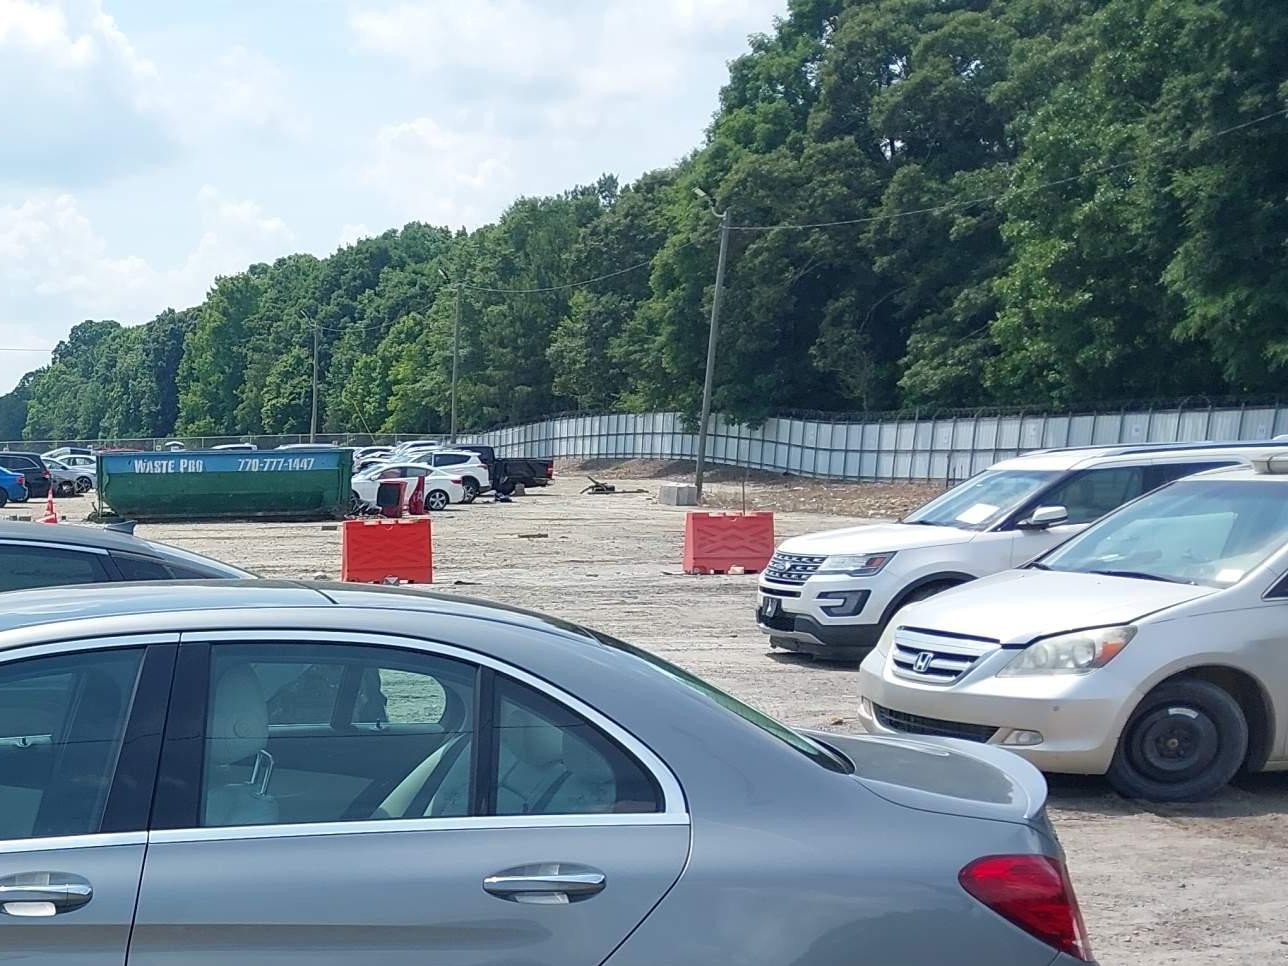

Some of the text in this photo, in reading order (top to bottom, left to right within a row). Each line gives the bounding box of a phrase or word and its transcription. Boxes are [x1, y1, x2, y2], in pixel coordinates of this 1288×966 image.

[134, 458, 203, 474] WASTE PRO
[237, 458, 315, 472] 770-777-1447
